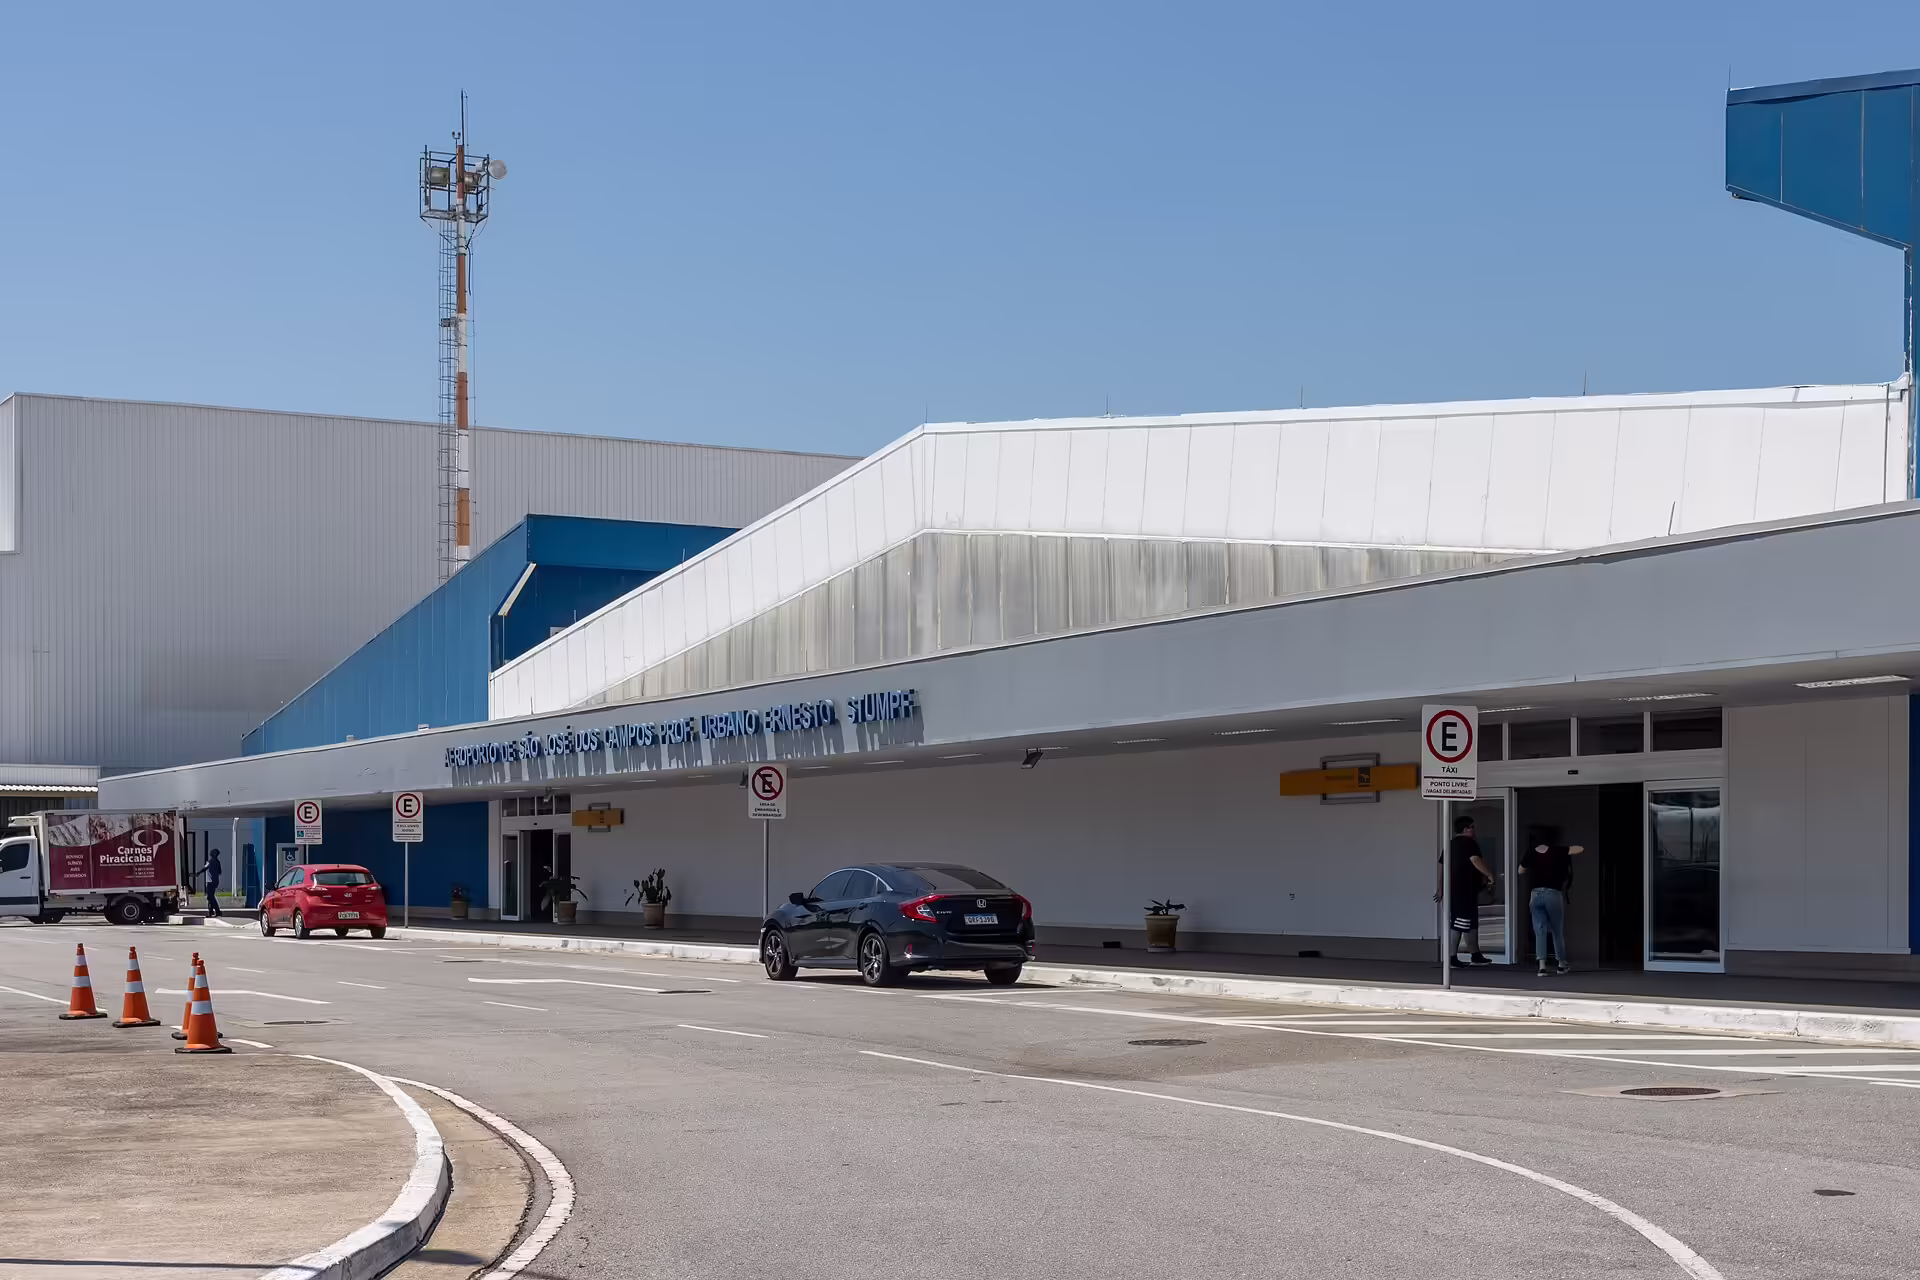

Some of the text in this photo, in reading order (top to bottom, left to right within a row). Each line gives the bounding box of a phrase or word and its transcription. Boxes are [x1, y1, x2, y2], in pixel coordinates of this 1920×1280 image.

[444, 743, 499, 767] AEROPORTO
[501, 741, 517, 762] DE
[518, 731, 541, 760] SÃO
[543, 725, 573, 756] JOSÉ
[575, 729, 599, 751] DOS
[603, 722, 656, 749] CAMPOS
[701, 709, 760, 740] URBANO
[764, 699, 835, 732] ERNESTO
[847, 689, 916, 724] STUMPF
[1441, 721, 1458, 752] E
[1441, 766, 1458, 774] TÁXI
[403, 798, 413, 813] E
[304, 806, 313, 819] E
[117, 846, 152, 855] Carnes
[99, 854, 152, 863] Piracicaba
